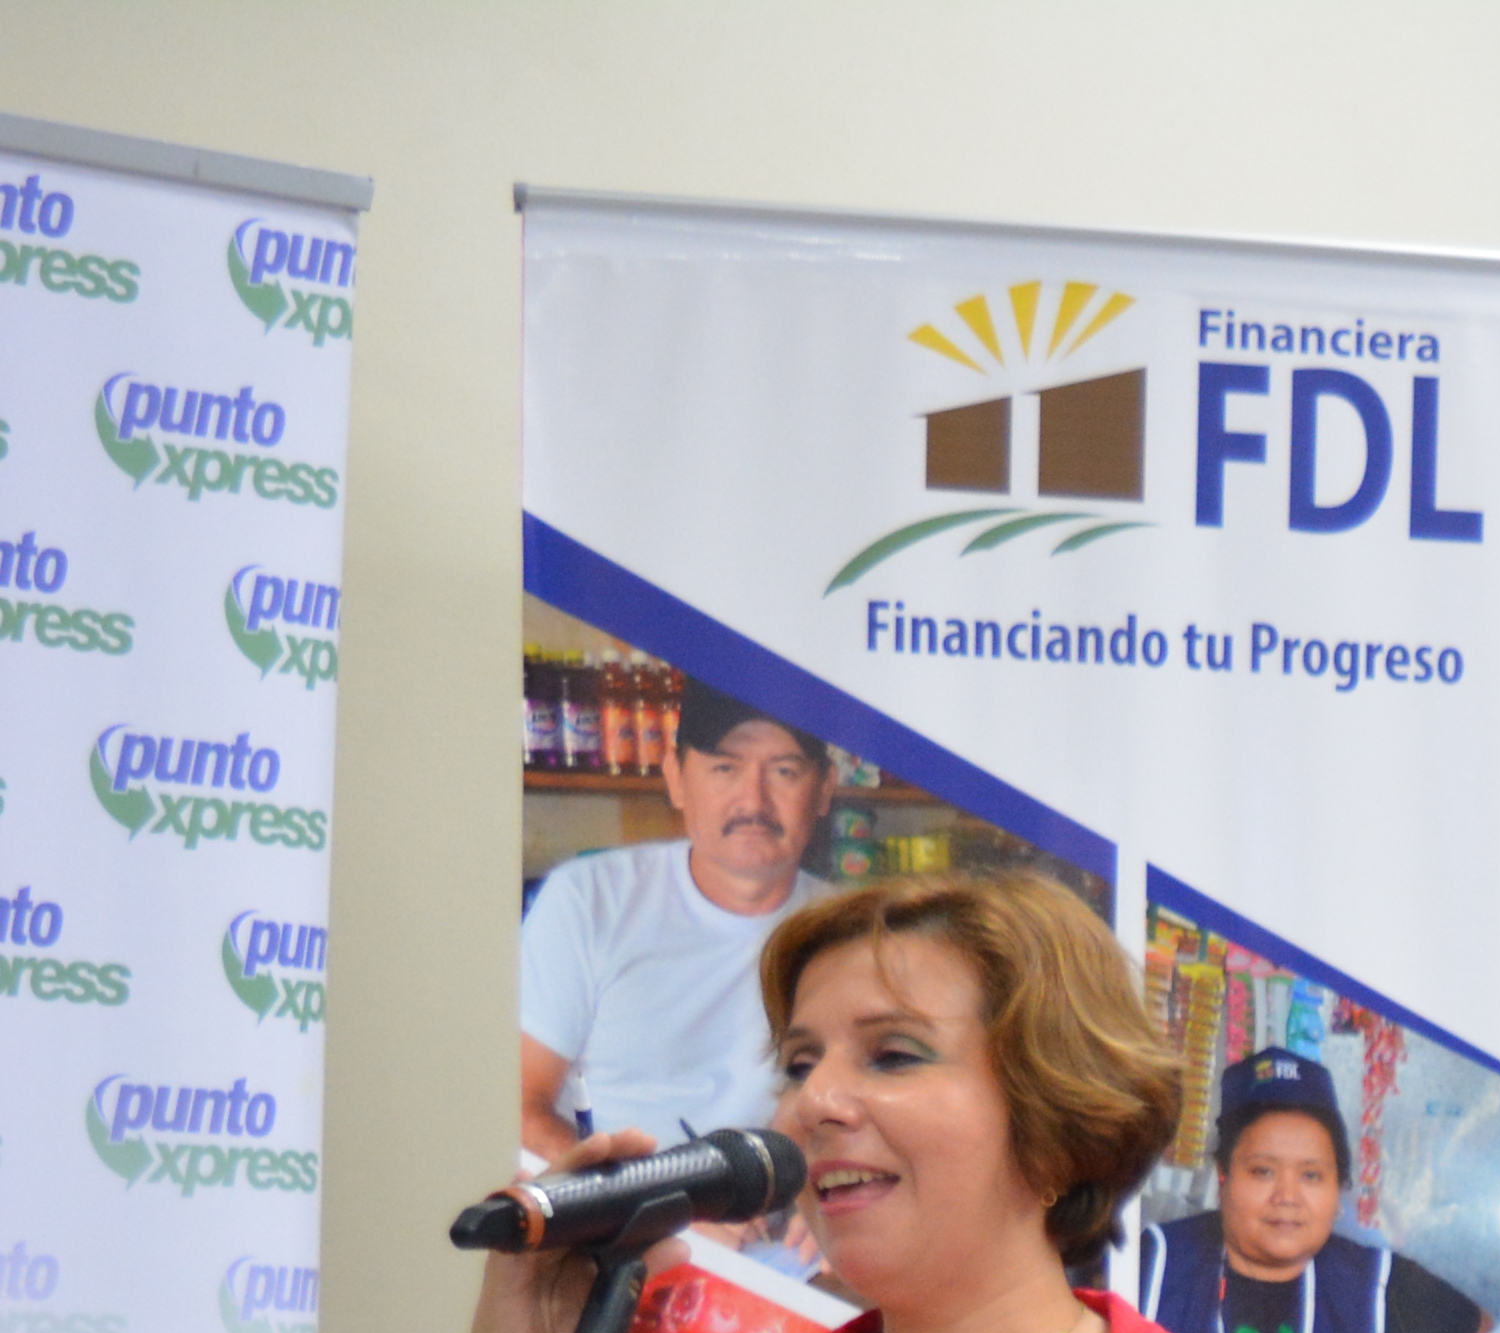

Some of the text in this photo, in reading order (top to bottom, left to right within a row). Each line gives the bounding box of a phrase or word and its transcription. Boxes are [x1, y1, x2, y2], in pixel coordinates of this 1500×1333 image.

[1198, 309, 1441, 363] Financiera
[117, 379, 286, 447] punto
[157, 442, 339, 509] xpress
[1195, 360, 1485, 545] FDL
[865, 600, 1464, 693] Financiando tu Progreso
[112, 731, 281, 793] punto
[150, 790, 327, 852] xpress
[0, 885, 63, 947] to
[0, 951, 132, 1006] ress
[109, 1077, 276, 1142] punto
[149, 1140, 318, 1199] xpress
